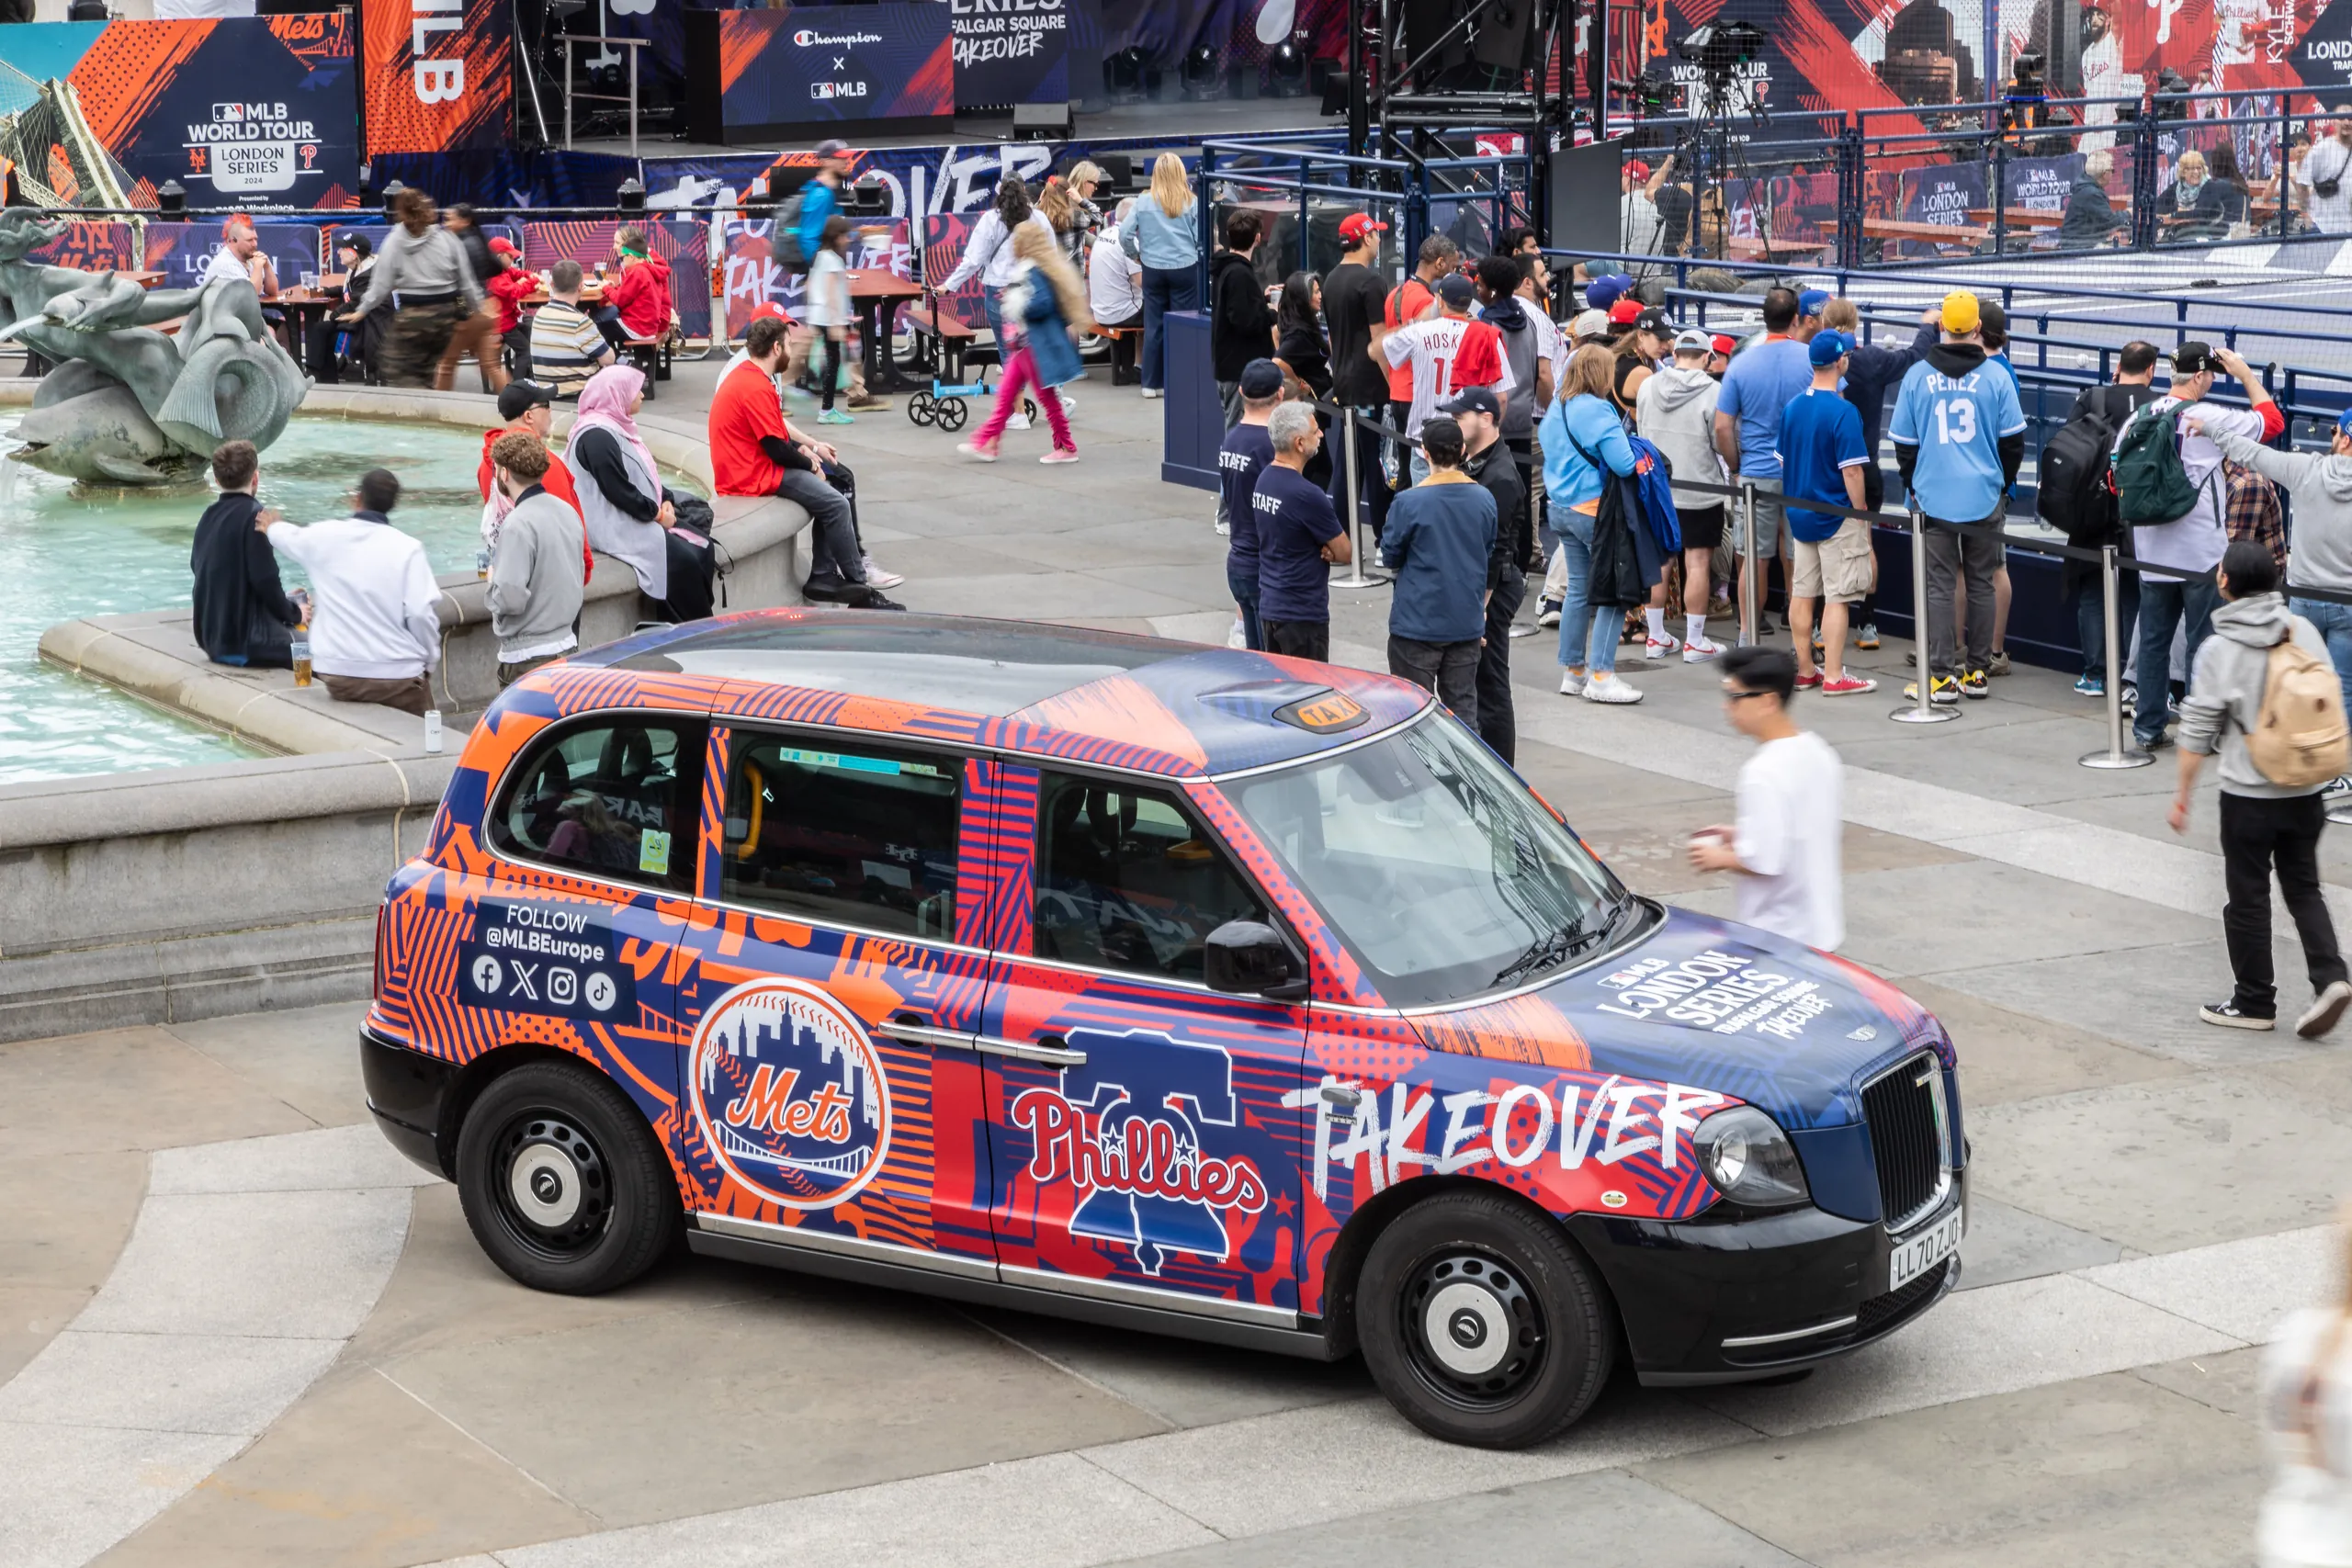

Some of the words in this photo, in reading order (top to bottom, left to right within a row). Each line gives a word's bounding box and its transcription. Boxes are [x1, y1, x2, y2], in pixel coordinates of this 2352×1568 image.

[268, 15, 326, 40] Mets
[1010, 15, 1066, 31] SQUARE
[1295, 30, 1309, 39] TM
[2267, 5, 2285, 63] KYLE
[413, 0, 464, 104] LB
[794, 29, 882, 50] Champion
[952, 29, 1045, 69] TAKEOVER
[835, 82, 867, 97] MLB
[245, 102, 288, 121] MLB
[187, 122, 260, 141] WORLD
[261, 121, 314, 140] TOUR
[221, 147, 285, 161] LONDON
[228, 161, 278, 175] SERIES
[1922, 190, 1969, 212] LONDON
[1927, 209, 1963, 227] SERIES
[1926, 371, 1981, 394] PEREZ
[1934, 398, 1976, 445] 13
[1218, 450, 1252, 472] STAFF
[1251, 491, 1283, 515] STAFF
[1302, 696, 1360, 724] TAXI
[506, 904, 588, 934] FOLLOW
[486, 926, 605, 964] @MLBEurope
[1596, 949, 1752, 1020] LONDON
[1666, 968, 1790, 1026] SERIES
[1756, 993, 1834, 1040] TAKEOVER
[725, 1063, 854, 1145] Mets
[865, 1104, 877, 1112] TM
[1012, 1088, 1269, 1213] Phillies
[1280, 1075, 1724, 1204] TAKEOVER
[1897, 1235, 1934, 1283] LL70
